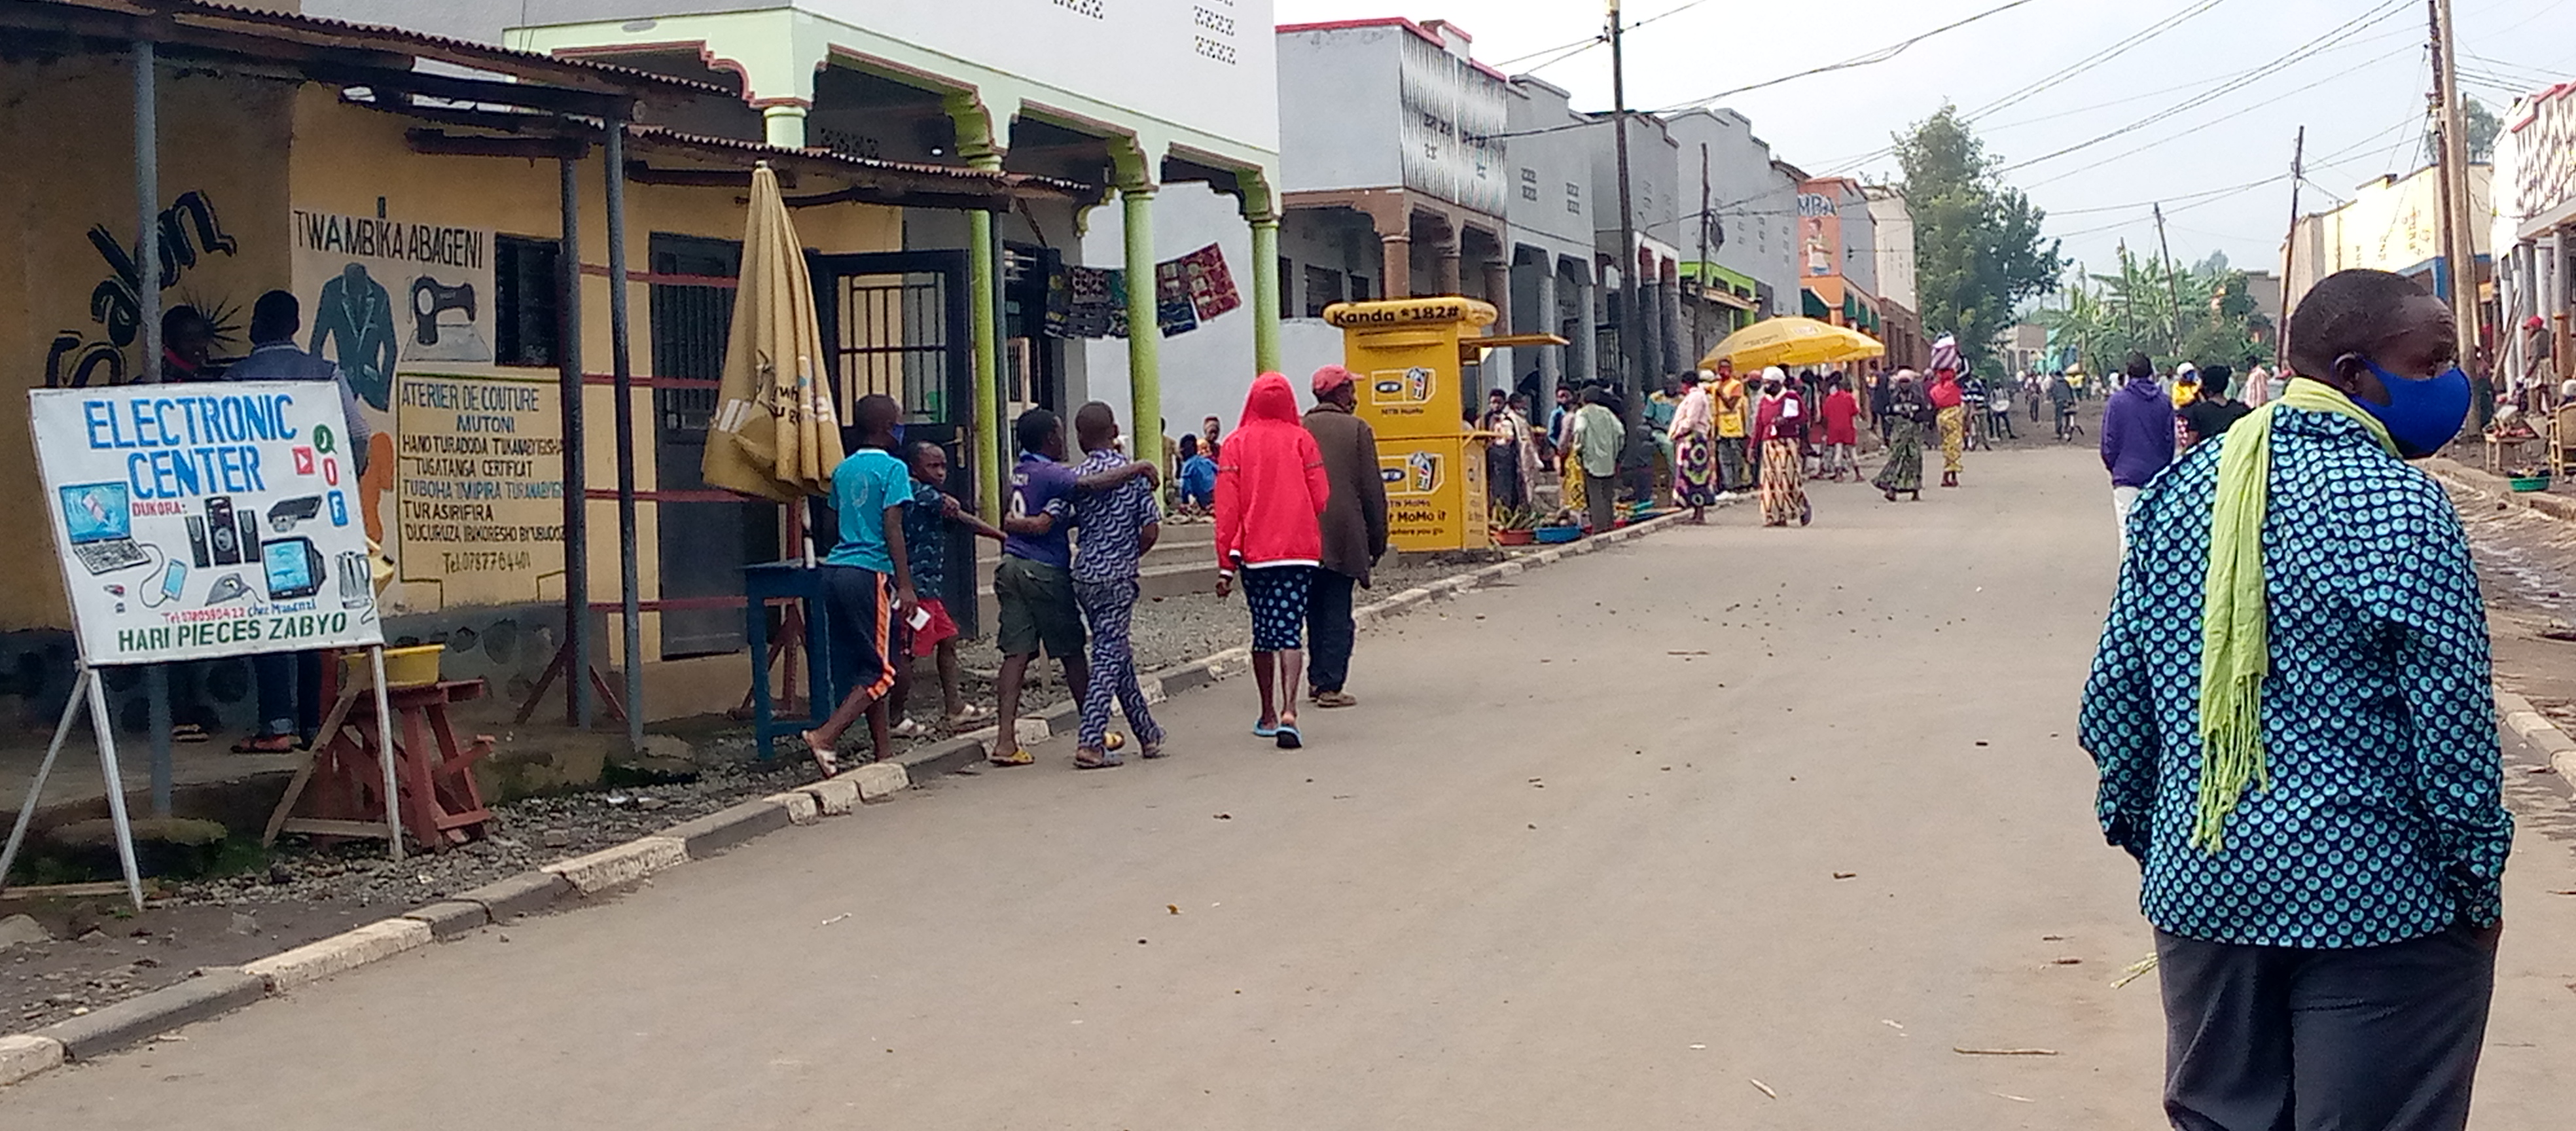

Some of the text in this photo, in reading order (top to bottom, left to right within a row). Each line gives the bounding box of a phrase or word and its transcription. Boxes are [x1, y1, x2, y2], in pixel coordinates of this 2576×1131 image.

[294, 210, 483, 269] TWAMBIKA ABAGENI
[1333, 308, 1395, 325] Kanda
[402, 382, 540, 412] ATERIER DE COUTURE
[83, 394, 297, 449] ELECTRONIC
[456, 415, 515, 433] MUTONI
[127, 445, 265, 499] CENTER
[1397, 511, 1434, 523] MoMo
[118, 612, 347, 653] HARI PIECES ZABYO
